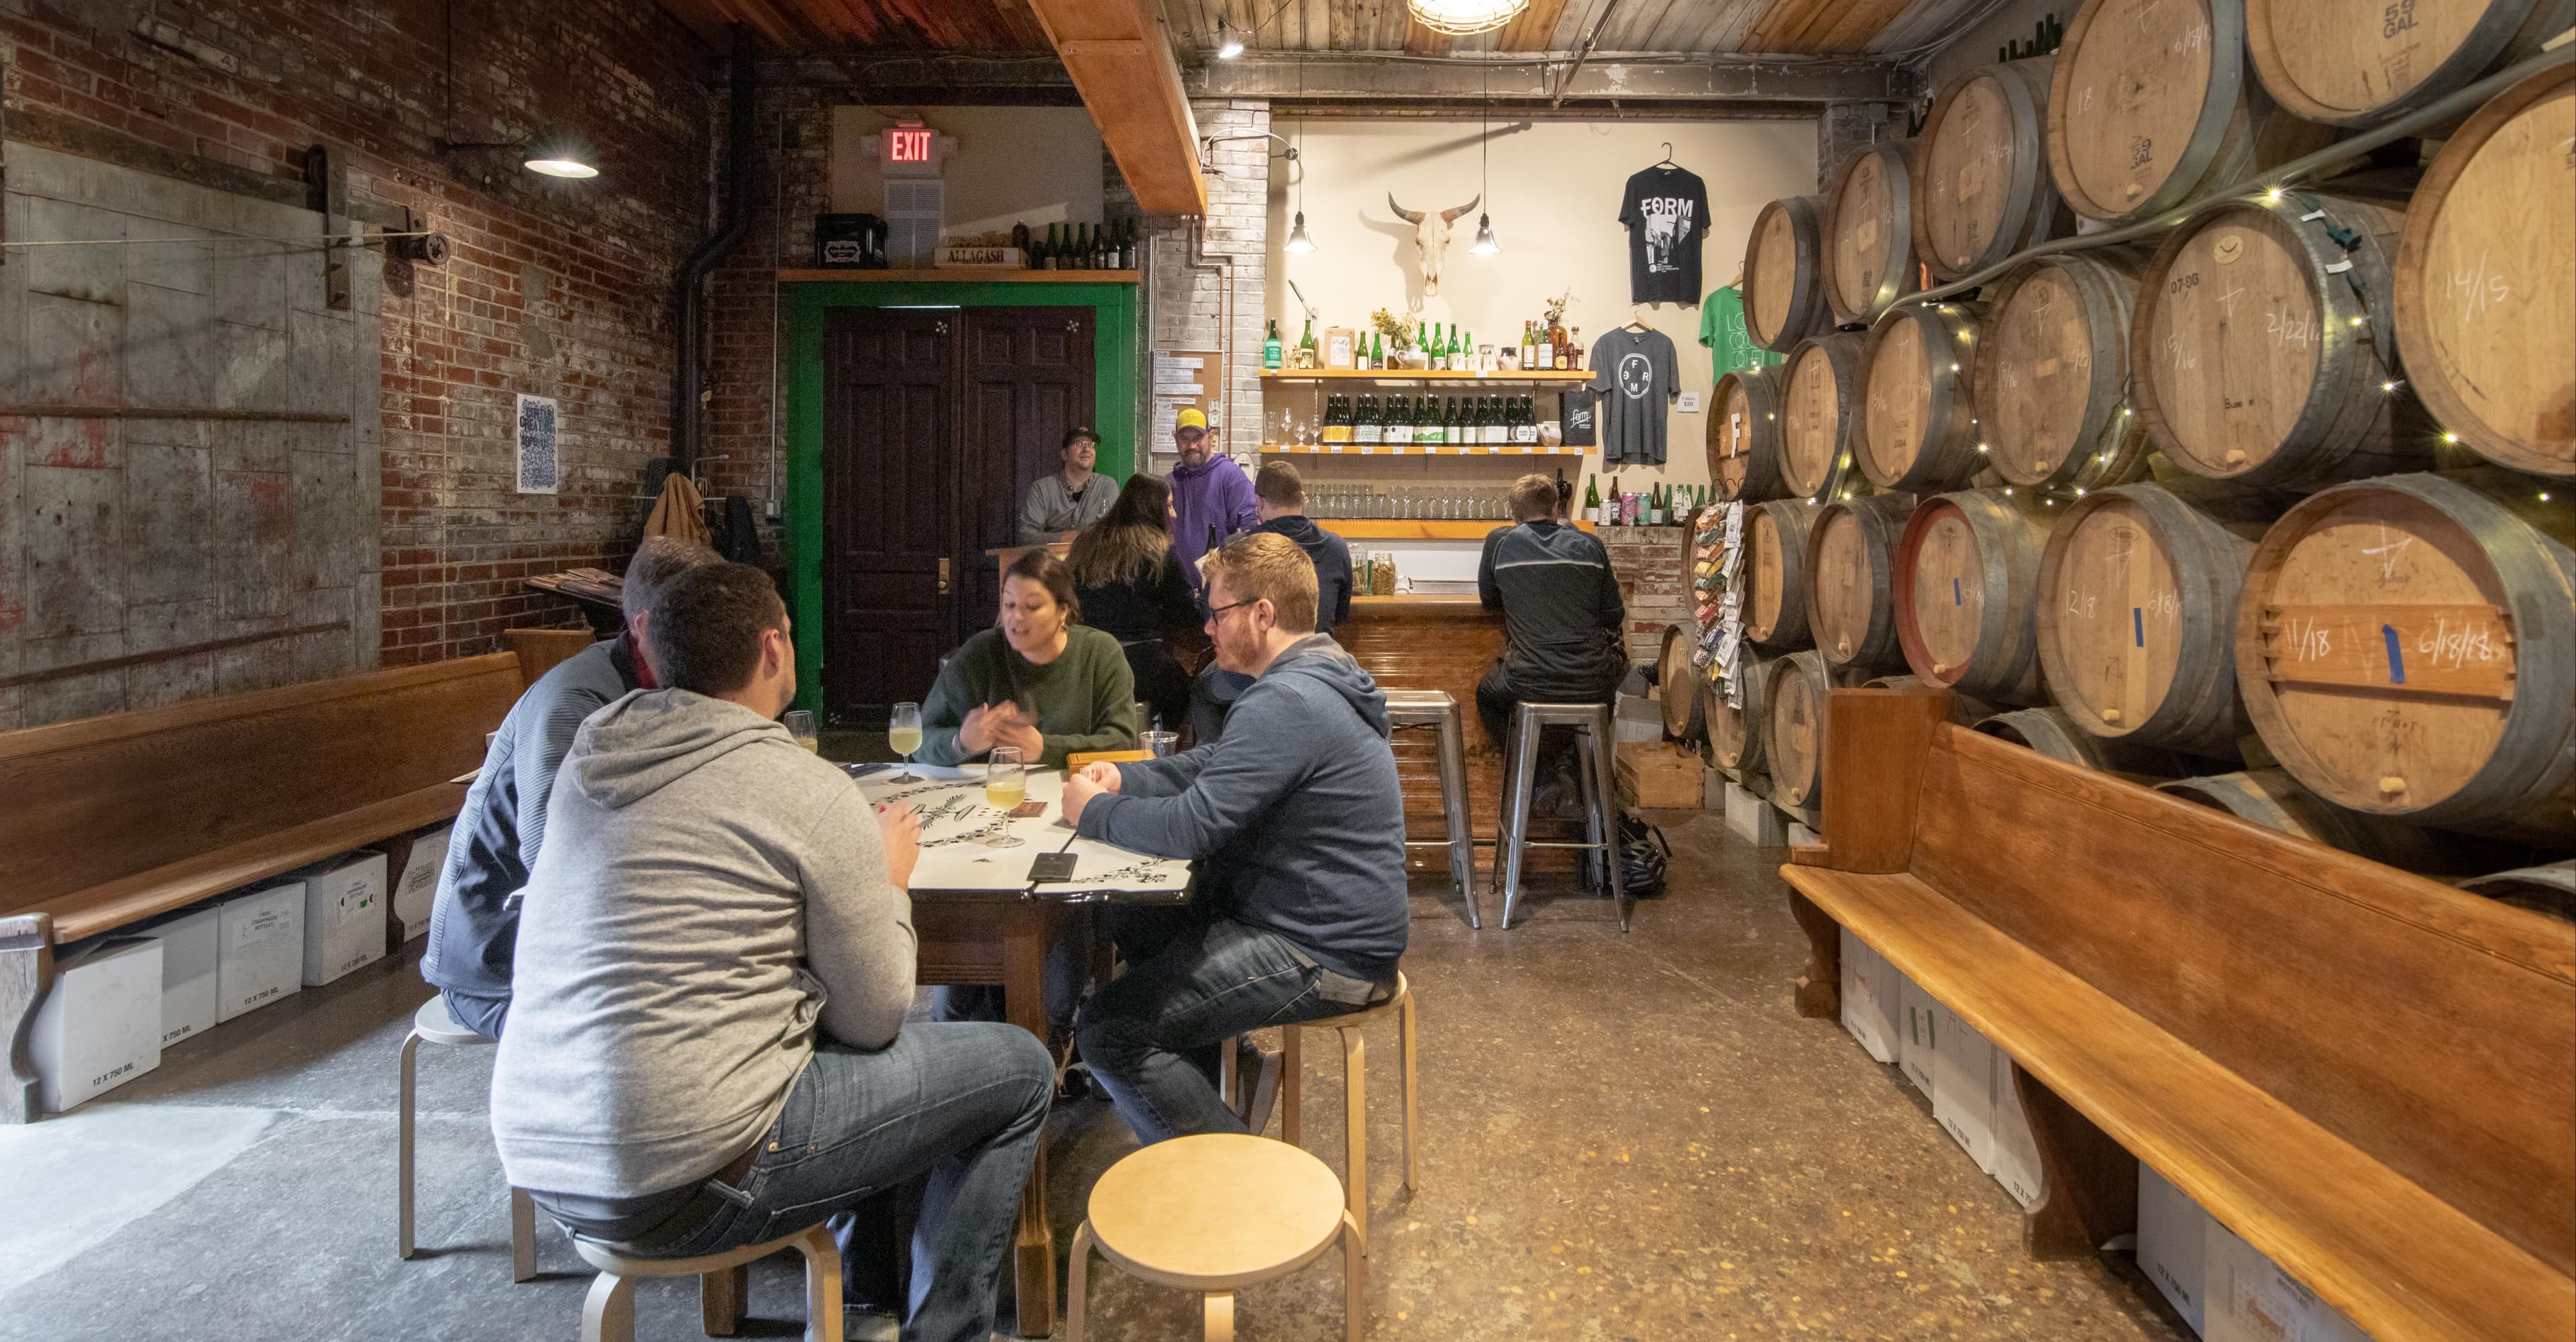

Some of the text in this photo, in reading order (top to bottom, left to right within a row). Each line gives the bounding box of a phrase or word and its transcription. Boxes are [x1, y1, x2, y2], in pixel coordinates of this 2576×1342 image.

[2383, 13, 2418, 39] GAL
[892, 132, 931, 161] EXIT
[1640, 197, 1693, 219] FORM
[947, 250, 1005, 263] ALLAGASH
[2447, 248, 2509, 322] 14/15
[1631, 382, 1638, 392] M
[1731, 413, 1740, 458] F
[252, 915, 278, 925] CHAMPAGNE
[255, 922, 274, 931] BOTTLES
[258, 990, 269, 1000] 750
[169, 1029, 180, 1040] 750
[182, 1025, 192, 1034] ML
[93, 1062, 134, 1086] 12 X 750 ML
[1948, 1117, 1953, 1129] 12
[1956, 1127, 1964, 1140] 750
[2013, 1181, 2021, 1193] 12
[2021, 1188, 2025, 1197] X
